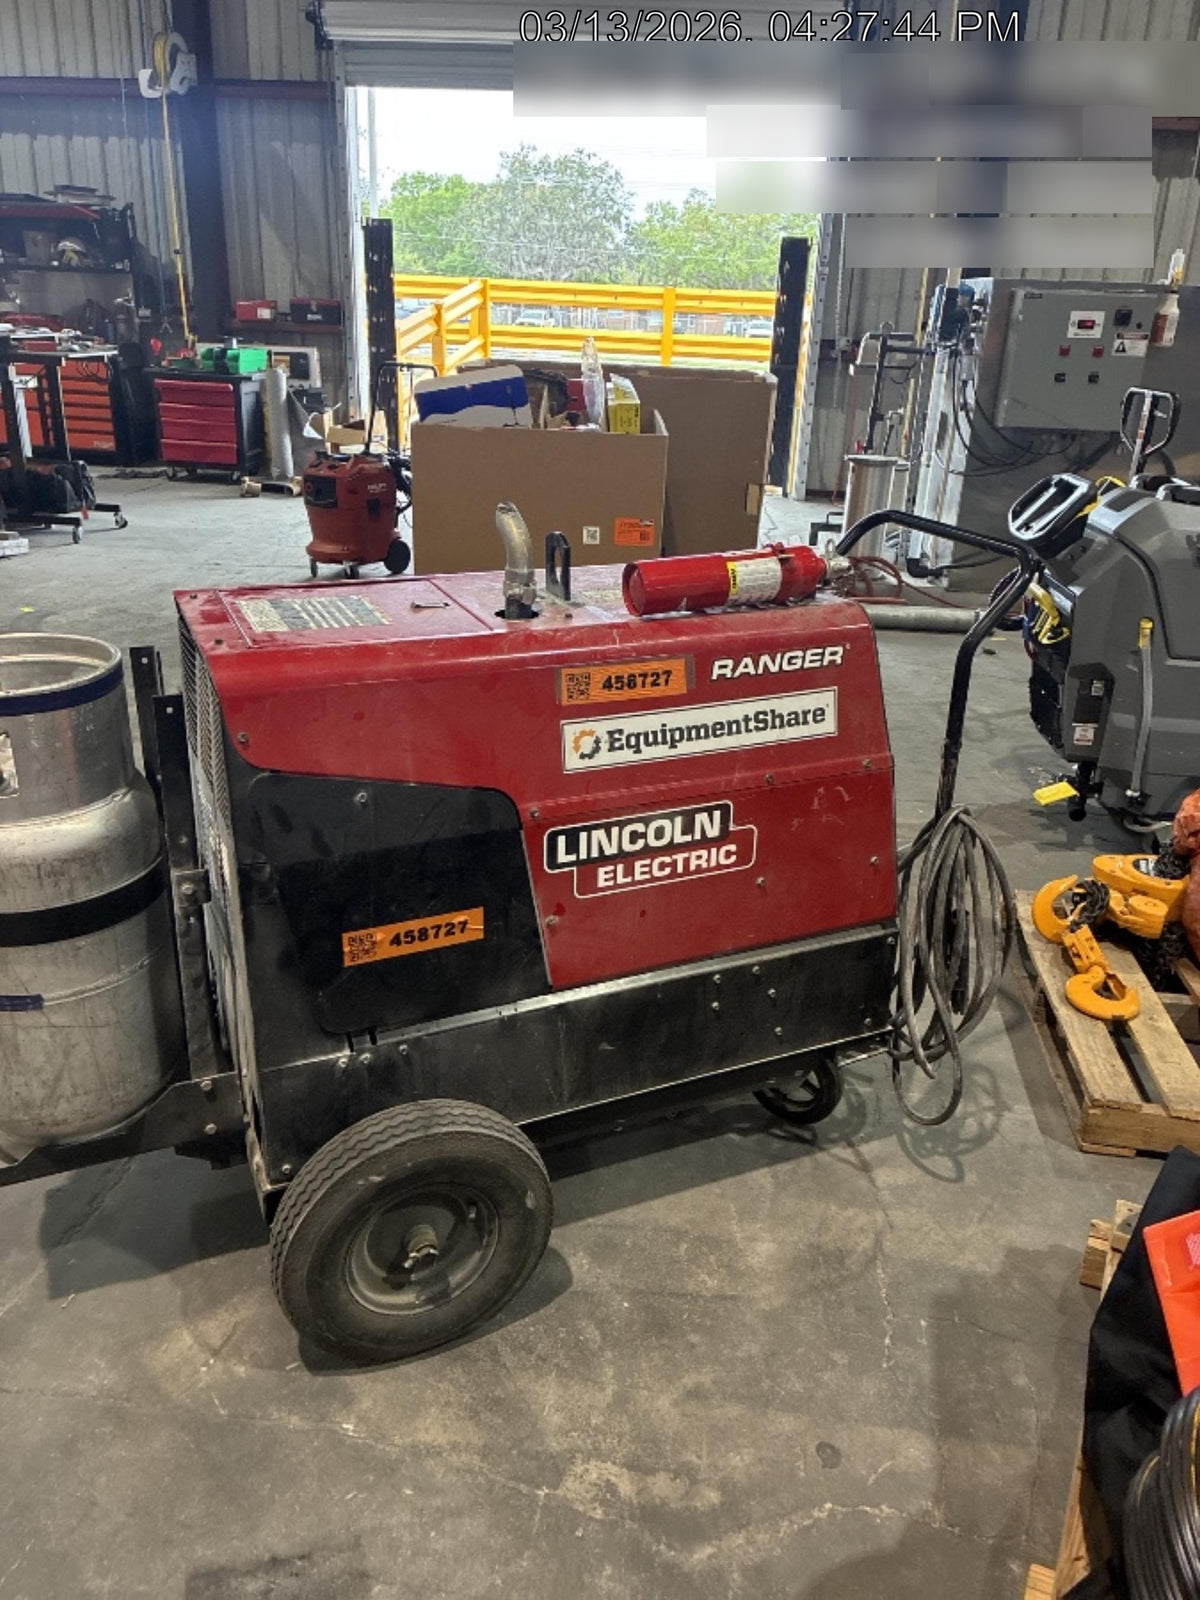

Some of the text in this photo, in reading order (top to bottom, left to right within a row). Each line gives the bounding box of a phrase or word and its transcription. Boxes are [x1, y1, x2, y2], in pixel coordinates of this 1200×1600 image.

[602, 670, 673, 692] 458727
[711, 645, 844, 681] RANGER
[606, 706, 828, 754] EquipmentShare
[556, 810, 722, 864] LINCOLN
[597, 844, 738, 888] ELECTRIC
[389, 919, 469, 947] 458727
